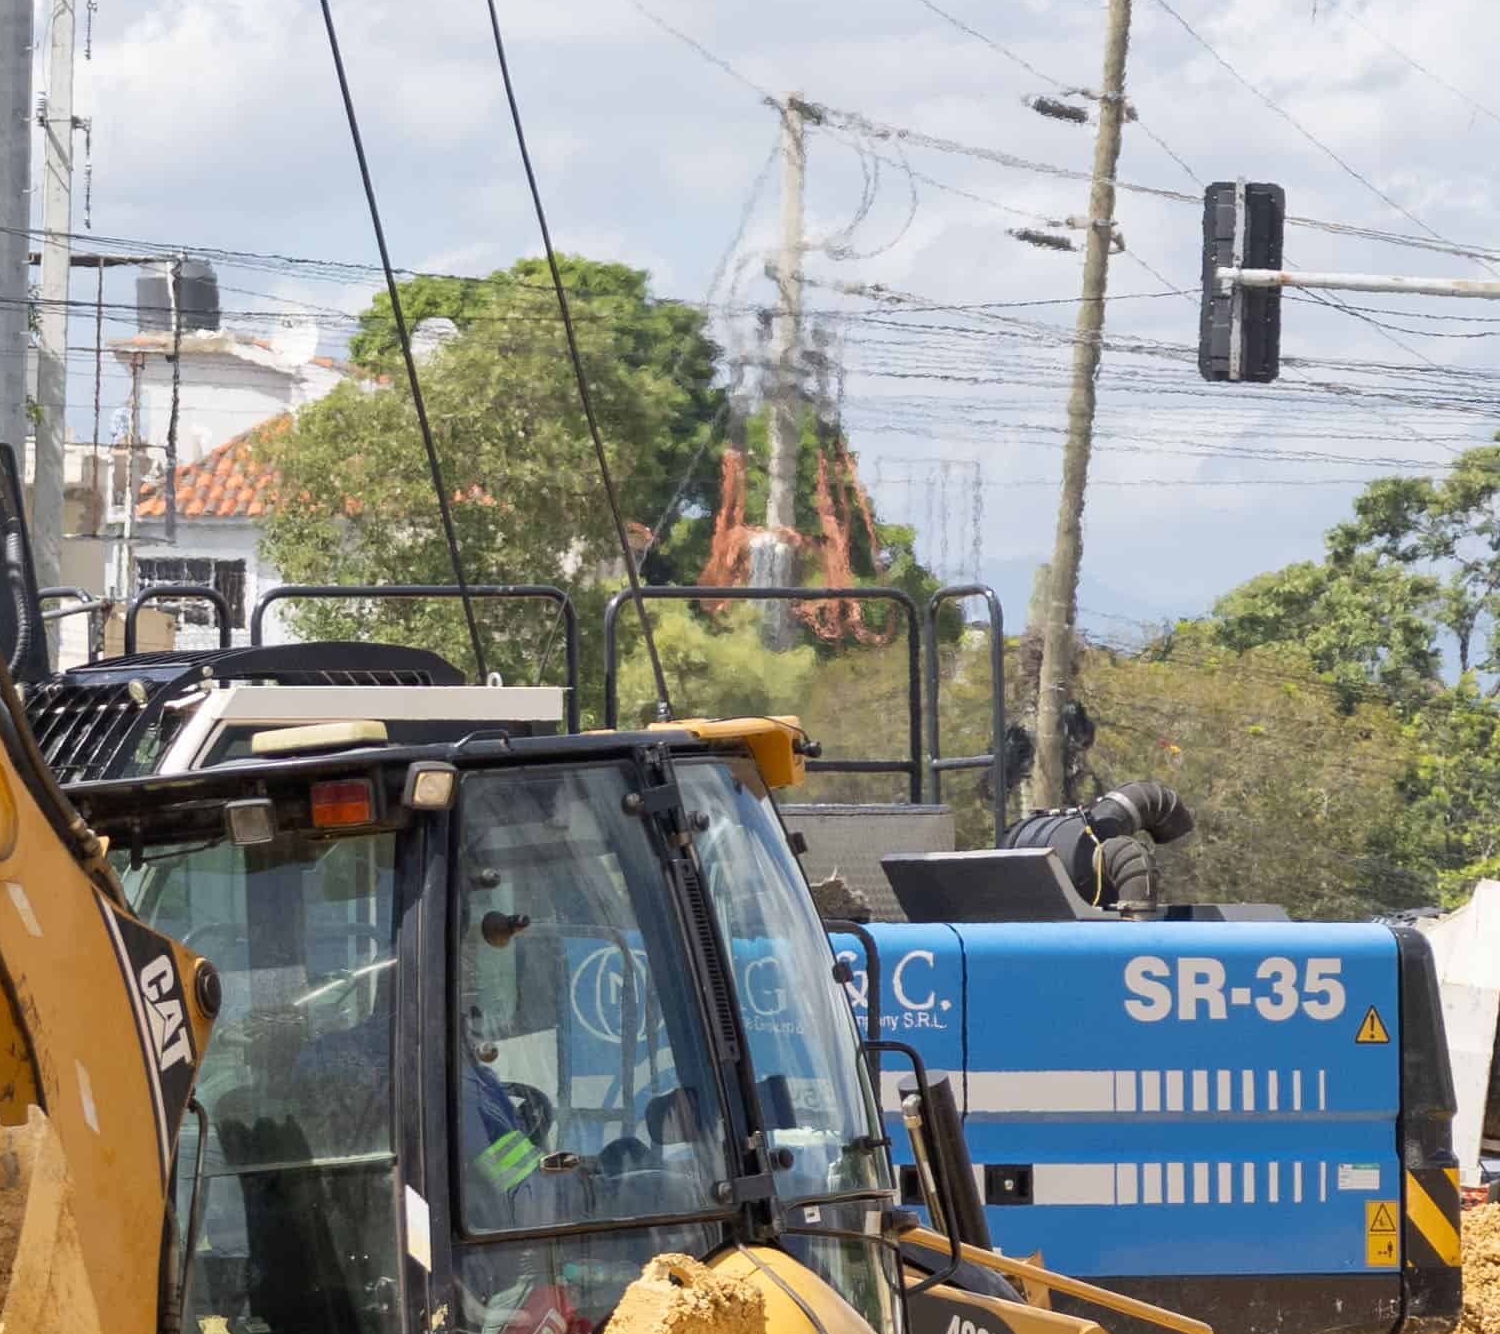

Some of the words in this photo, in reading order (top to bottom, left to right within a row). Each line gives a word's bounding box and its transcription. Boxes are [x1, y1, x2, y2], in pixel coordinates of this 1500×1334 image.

[140, 954, 194, 1072] CAT
[892, 949, 952, 1011] C.
[1123, 955, 1347, 1023] SR-35
